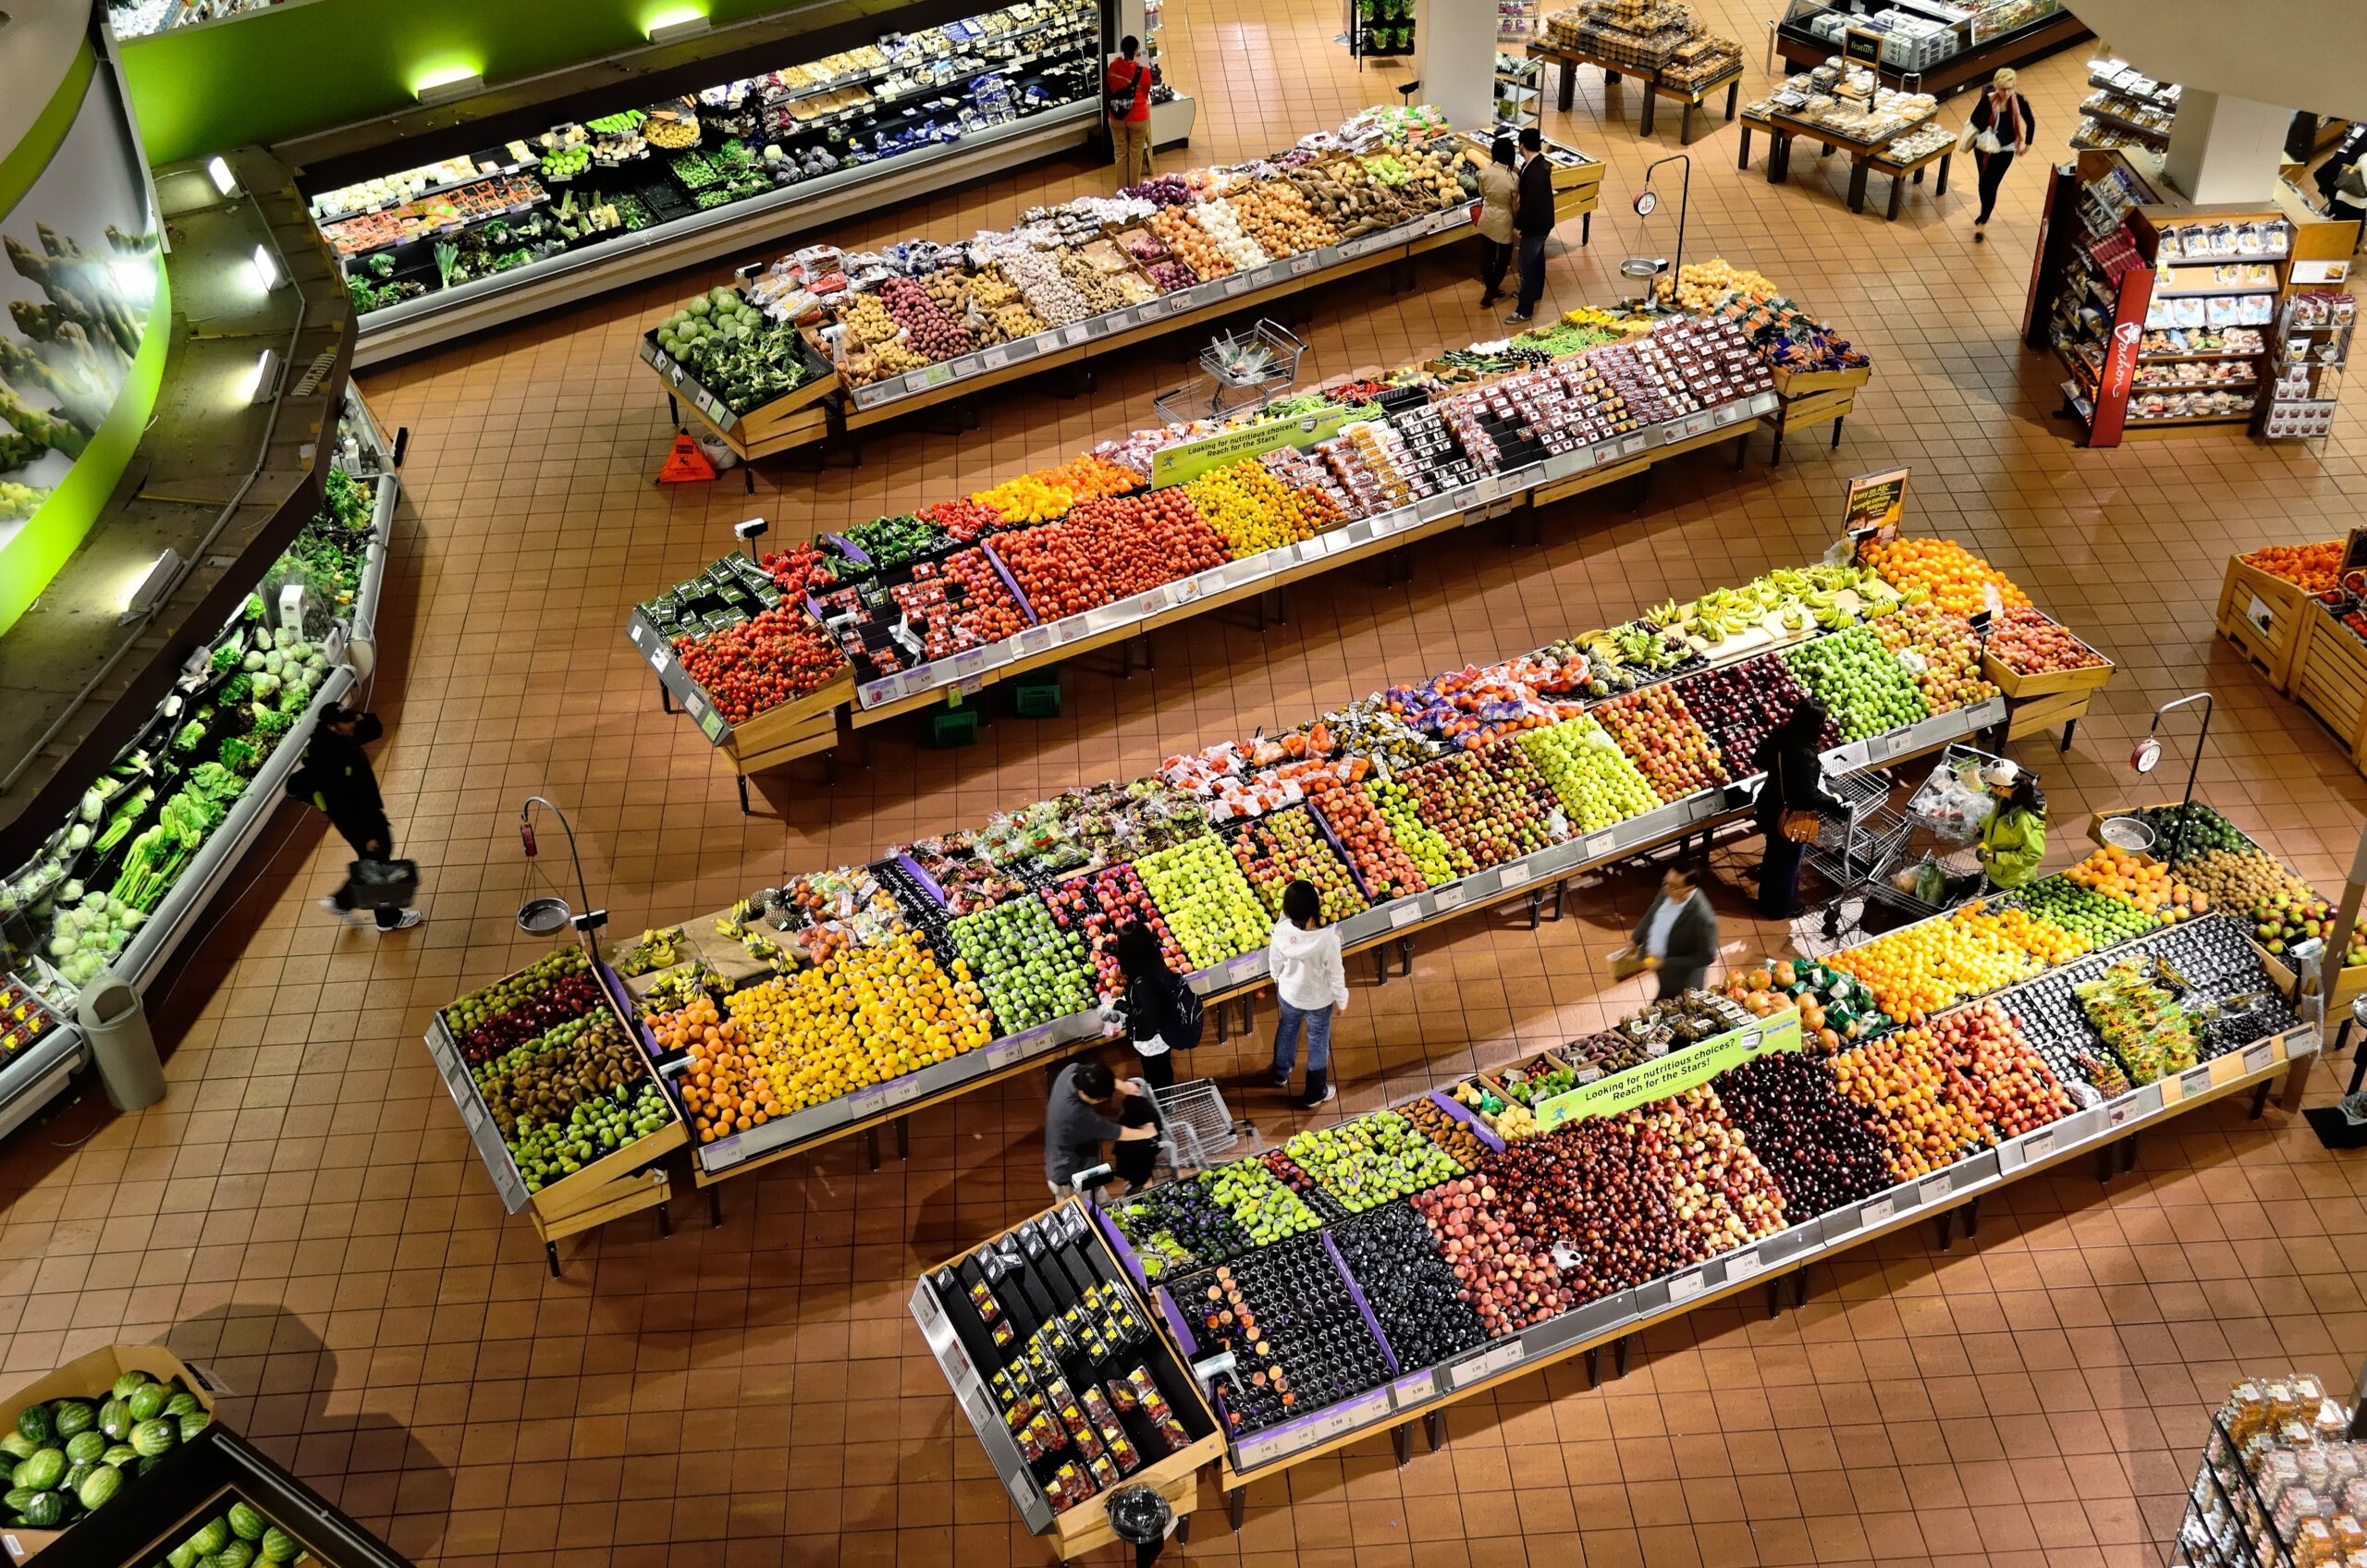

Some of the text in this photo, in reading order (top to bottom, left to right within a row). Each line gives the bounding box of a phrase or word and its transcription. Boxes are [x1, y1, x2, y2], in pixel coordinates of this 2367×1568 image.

[1188, 422, 1297, 455] Looking for nutritious choices?
[1207, 434, 1279, 458] Reach for the Stars!
[1854, 491, 1869, 501] Easy
[1877, 484, 1891, 492] ABC
[1586, 1038, 1735, 1101] Looking for nutritious choices?
[1613, 1058, 1711, 1101] Reach for the Stars!
